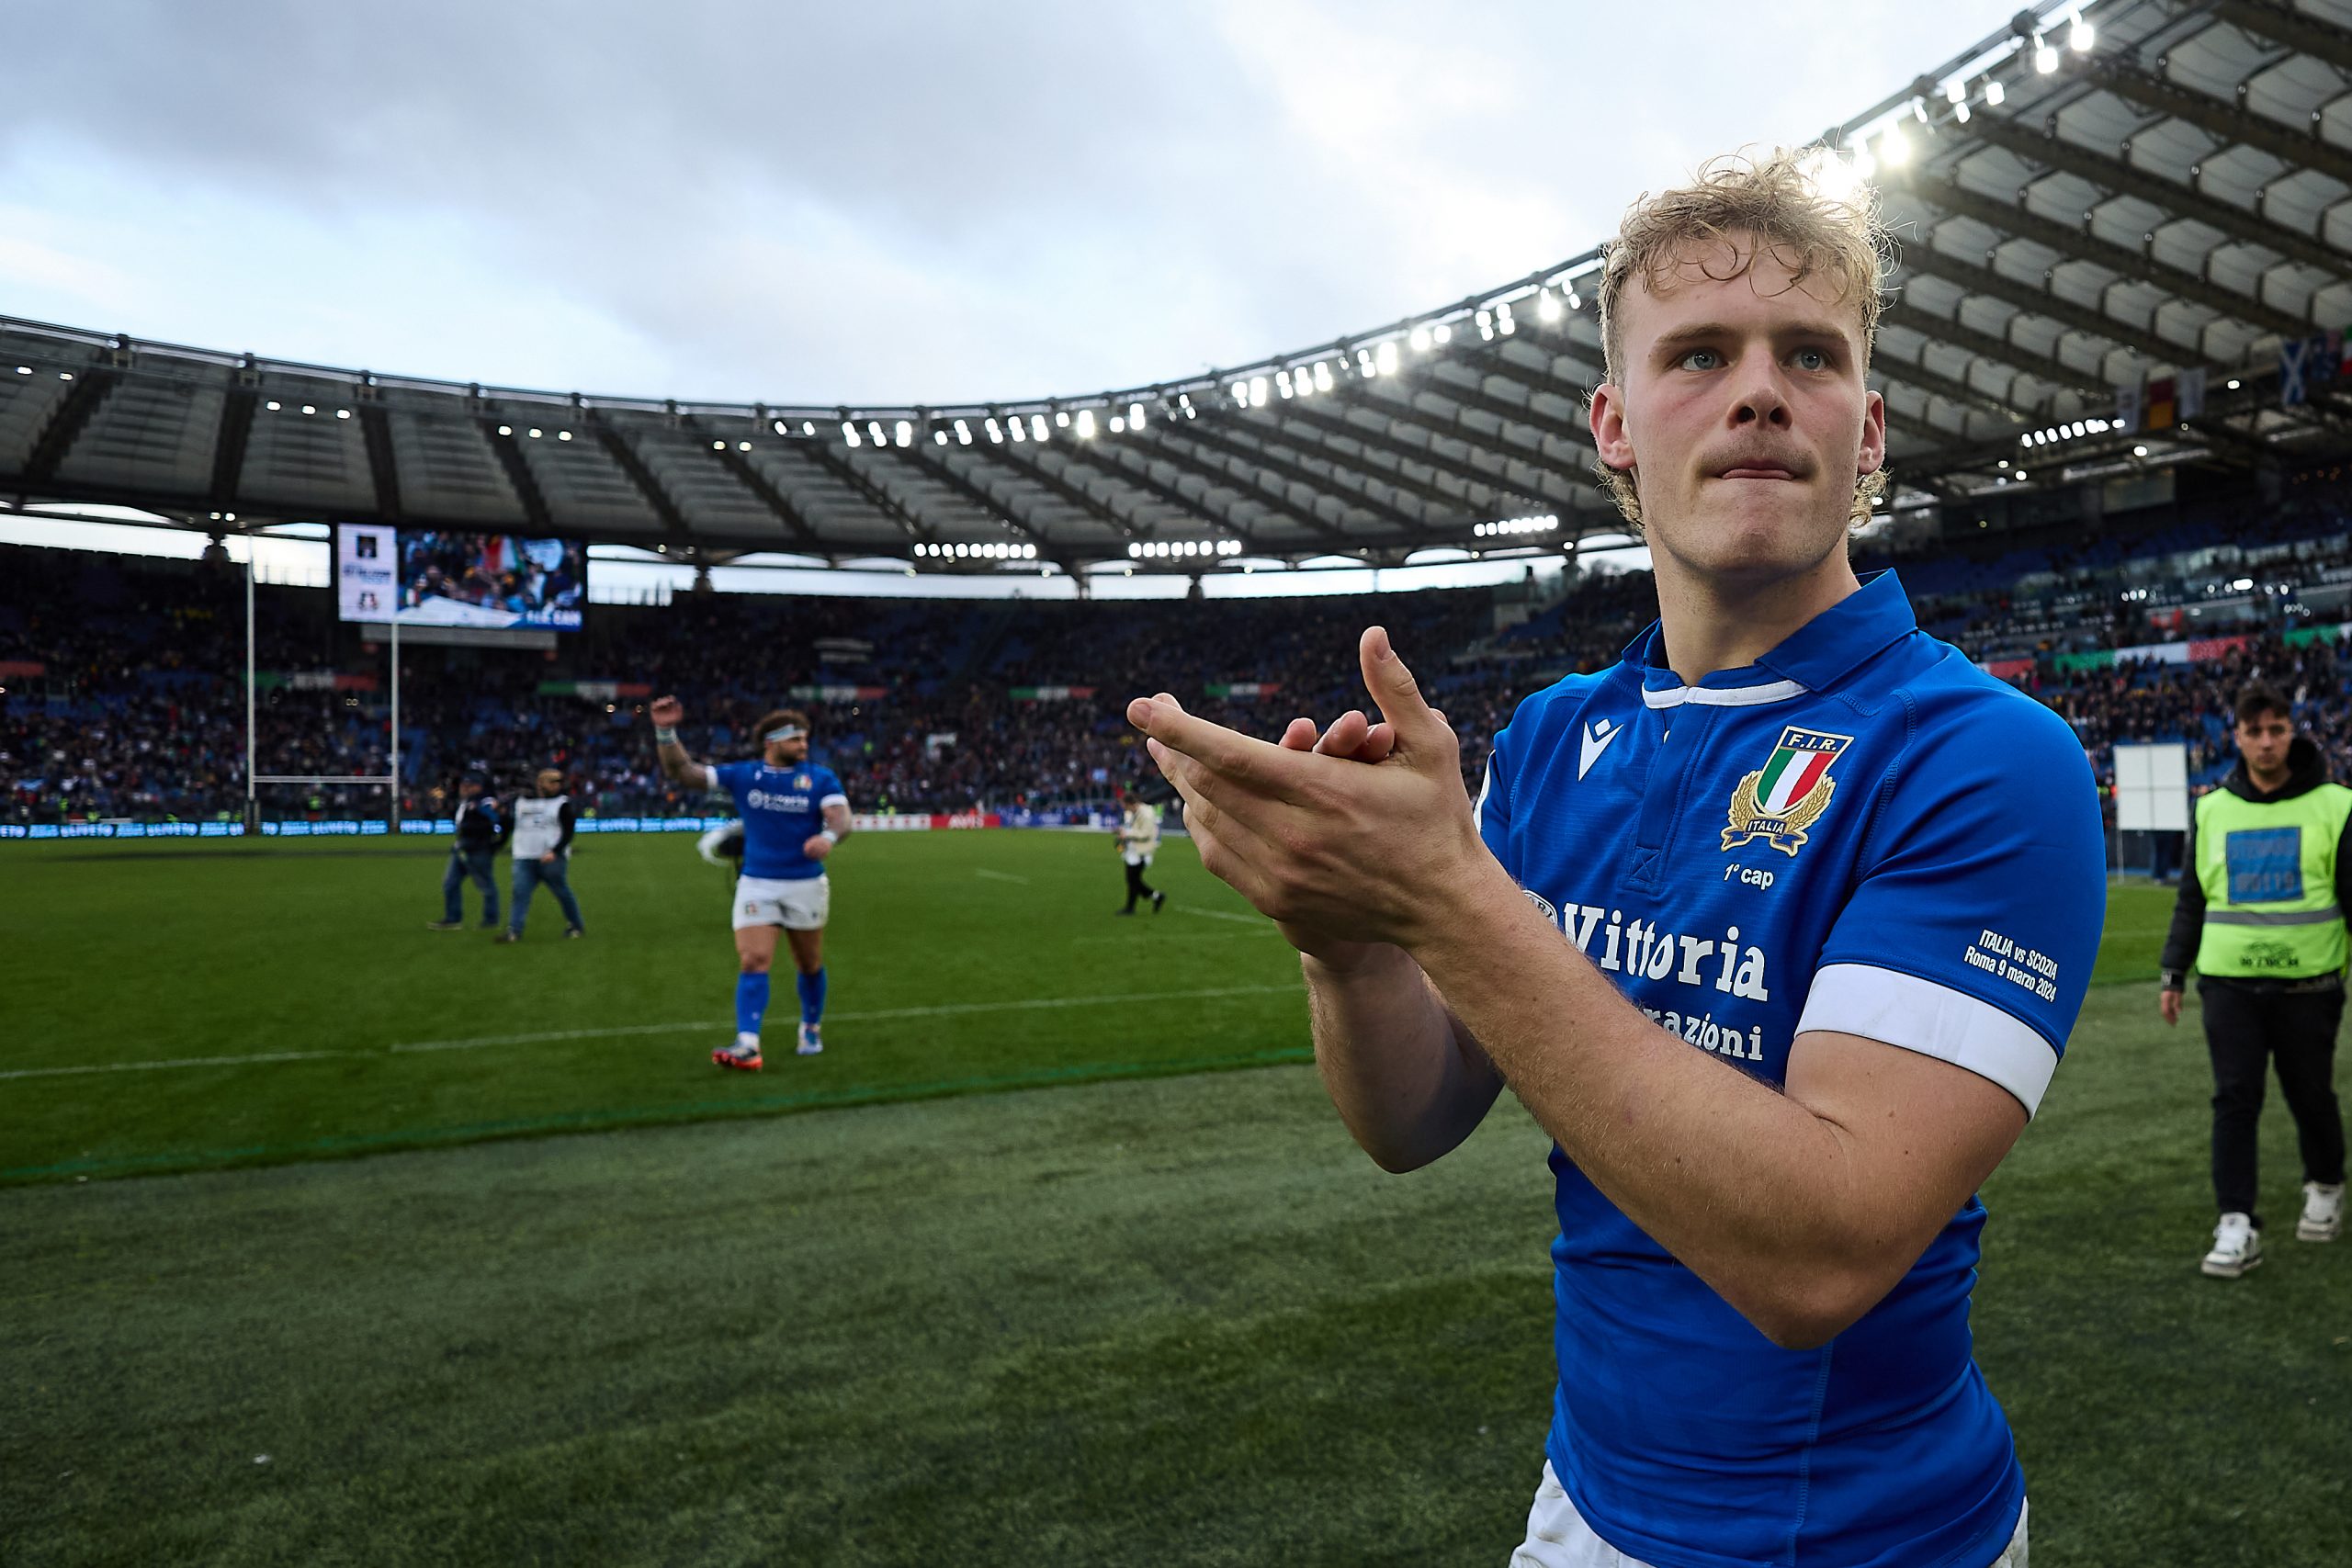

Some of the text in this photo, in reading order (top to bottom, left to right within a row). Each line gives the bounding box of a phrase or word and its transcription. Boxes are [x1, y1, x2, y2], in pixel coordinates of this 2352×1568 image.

[1788, 734, 1837, 750] F.I.R.
[1747, 819, 1785, 834] ITALIA
[1740, 868, 1774, 890] cap
[1564, 902, 1769, 1001] Vittoria
[1963, 945, 2057, 1003] Roma 9 marzo 2024
[1979, 929, 2058, 981] ITALIA vs SCOZIA
[1643, 1009, 1763, 1061] razioni
